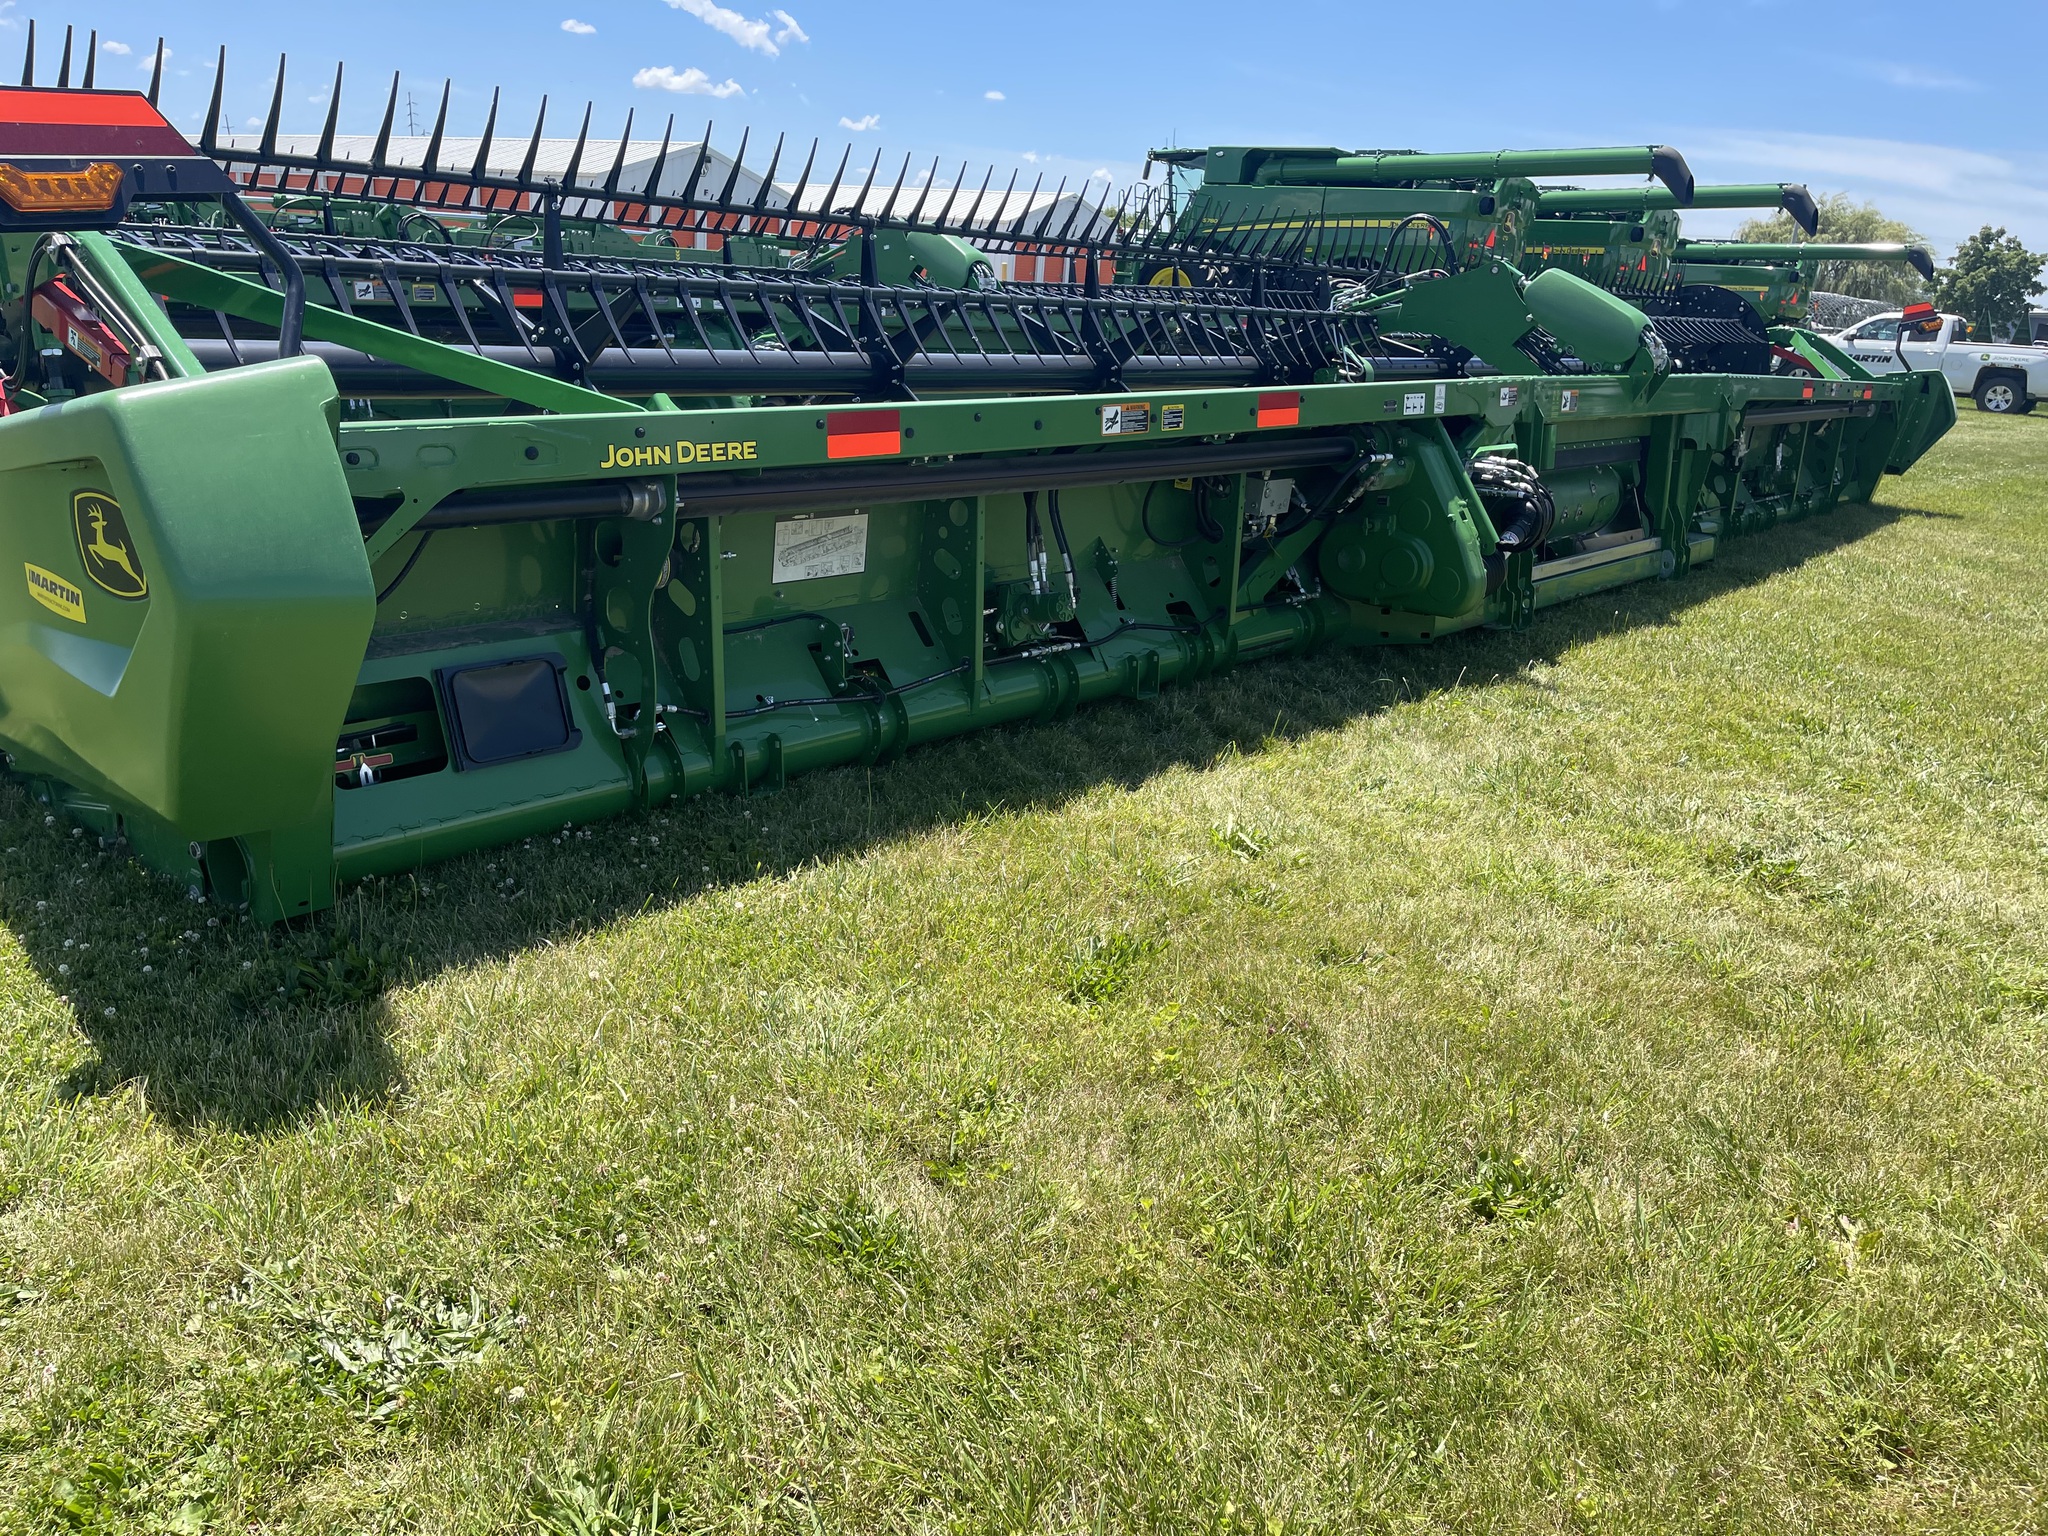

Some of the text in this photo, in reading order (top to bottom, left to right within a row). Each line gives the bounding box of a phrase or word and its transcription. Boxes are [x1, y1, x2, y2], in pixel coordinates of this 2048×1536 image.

[600, 440, 758, 469] JOHN DEERE
[31, 570, 80, 607] MARTIN
